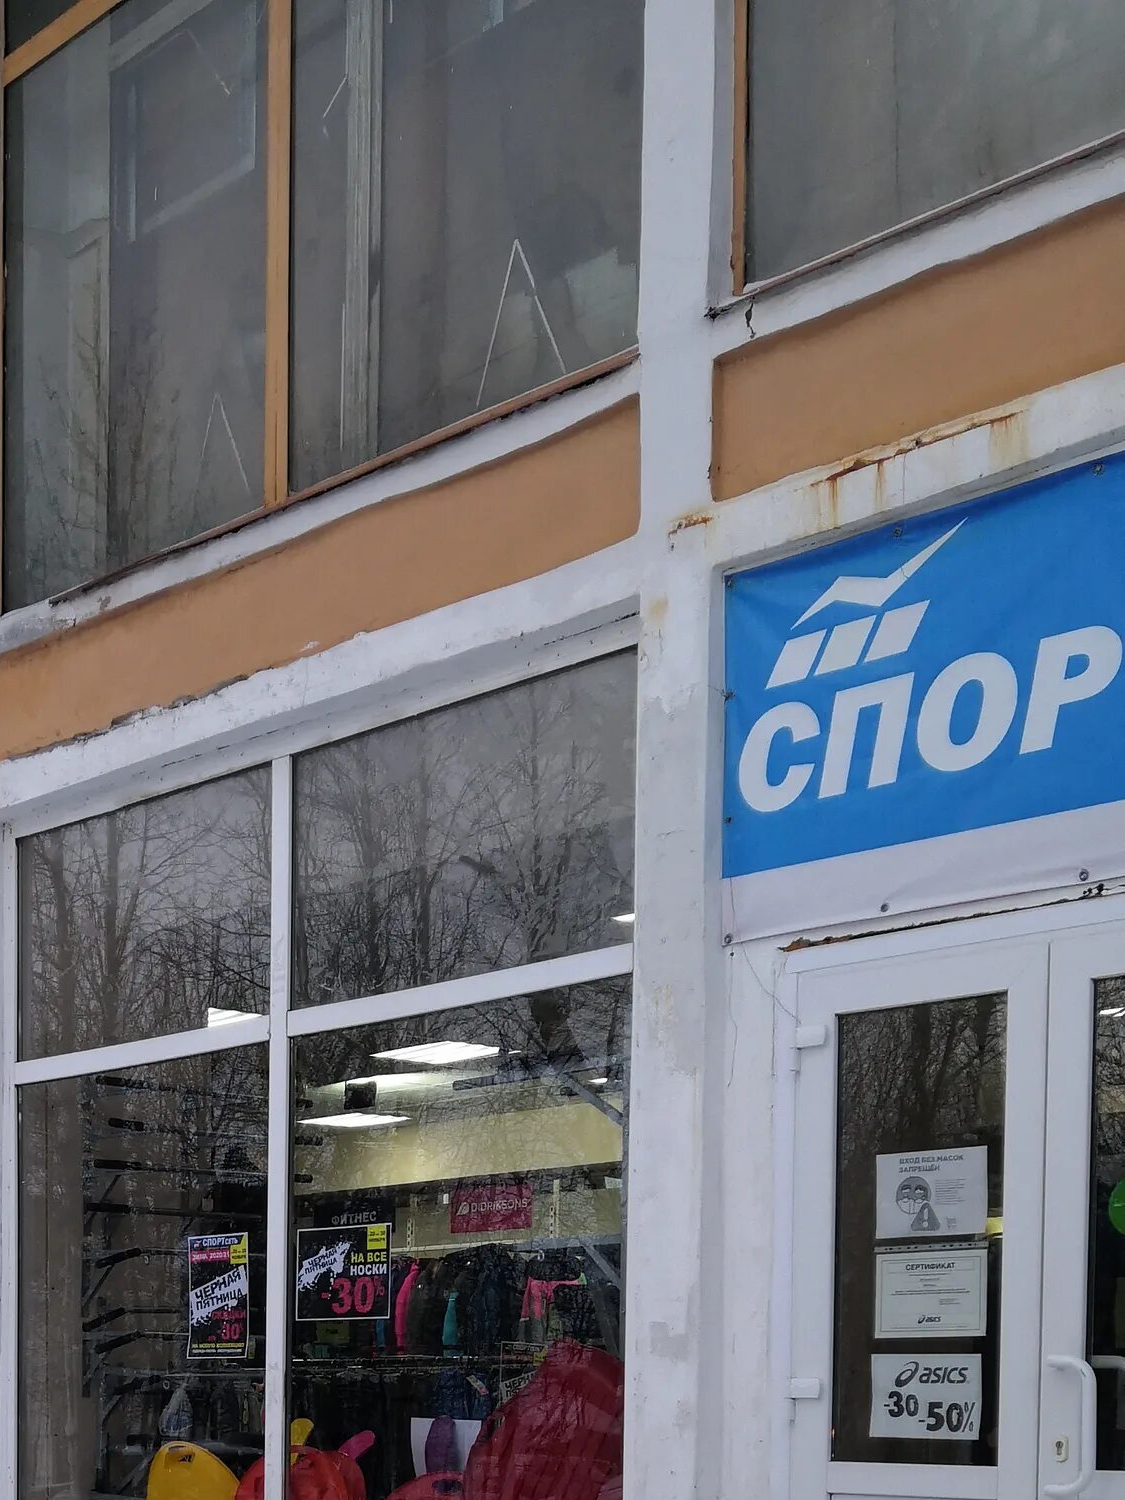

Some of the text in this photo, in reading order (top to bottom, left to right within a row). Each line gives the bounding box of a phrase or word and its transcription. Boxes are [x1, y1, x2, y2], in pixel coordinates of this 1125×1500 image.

[738, 626, 1123, 812] СПОР
[899, 1157, 920, 1165] ВХОД
[936, 1154, 964, 1162] МАСОК
[471, 1198, 528, 1213] DIDRIKSONS
[331, 1211, 377, 1225] ФИТНЕС
[304, 1257, 338, 1274] ПЯТНИЦА
[350, 1251, 387, 1264] НА ВСЕ
[905, 1261, 956, 1271] СЕРТИФИКАТ
[350, 1263, 388, 1276] НОСКИ
[194, 1270, 242, 1300] ЧЕРНАЯ
[196, 1287, 243, 1310] ПЯТНИЦА
[918, 1366, 969, 1384] asics
[884, 1390, 919, 1418] -30
[918, 1401, 976, 1433] -50%
